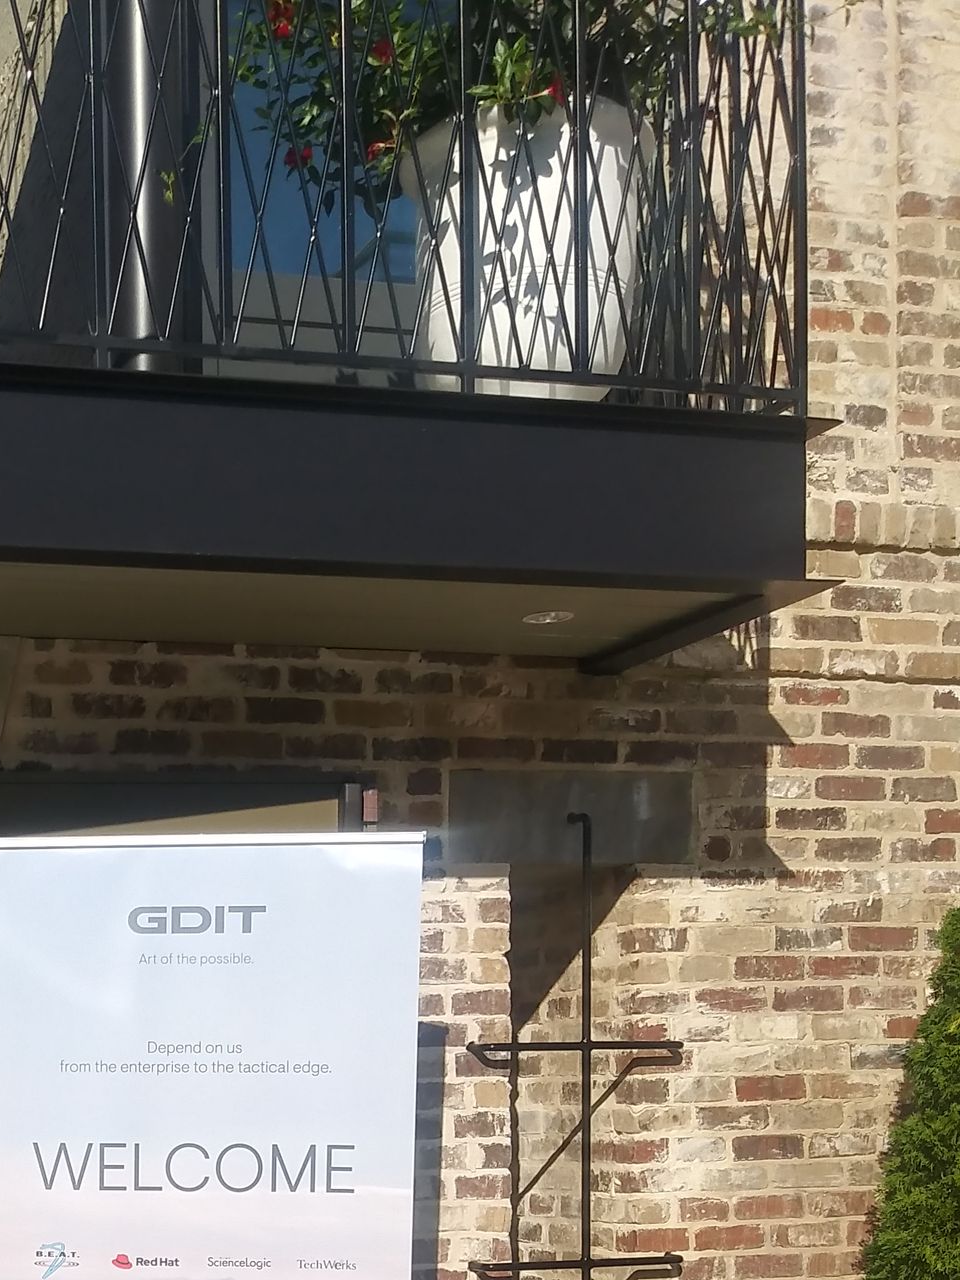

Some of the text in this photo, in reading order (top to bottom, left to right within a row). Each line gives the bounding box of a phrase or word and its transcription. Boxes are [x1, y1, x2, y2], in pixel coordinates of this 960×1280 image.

[127, 905, 267, 934] GDIT
[138, 953, 255, 967] Art of the possible.
[147, 1040, 243, 1057] Depend on us
[60, 1059, 332, 1077] from the enterprise to the tactical edge.
[32, 1142, 356, 1194] WELCOME
[35, 1250, 81, 1259] B.E.A.T.
[135, 1257, 180, 1267] Red Hat
[207, 1256, 272, 1270] ScienceLogic
